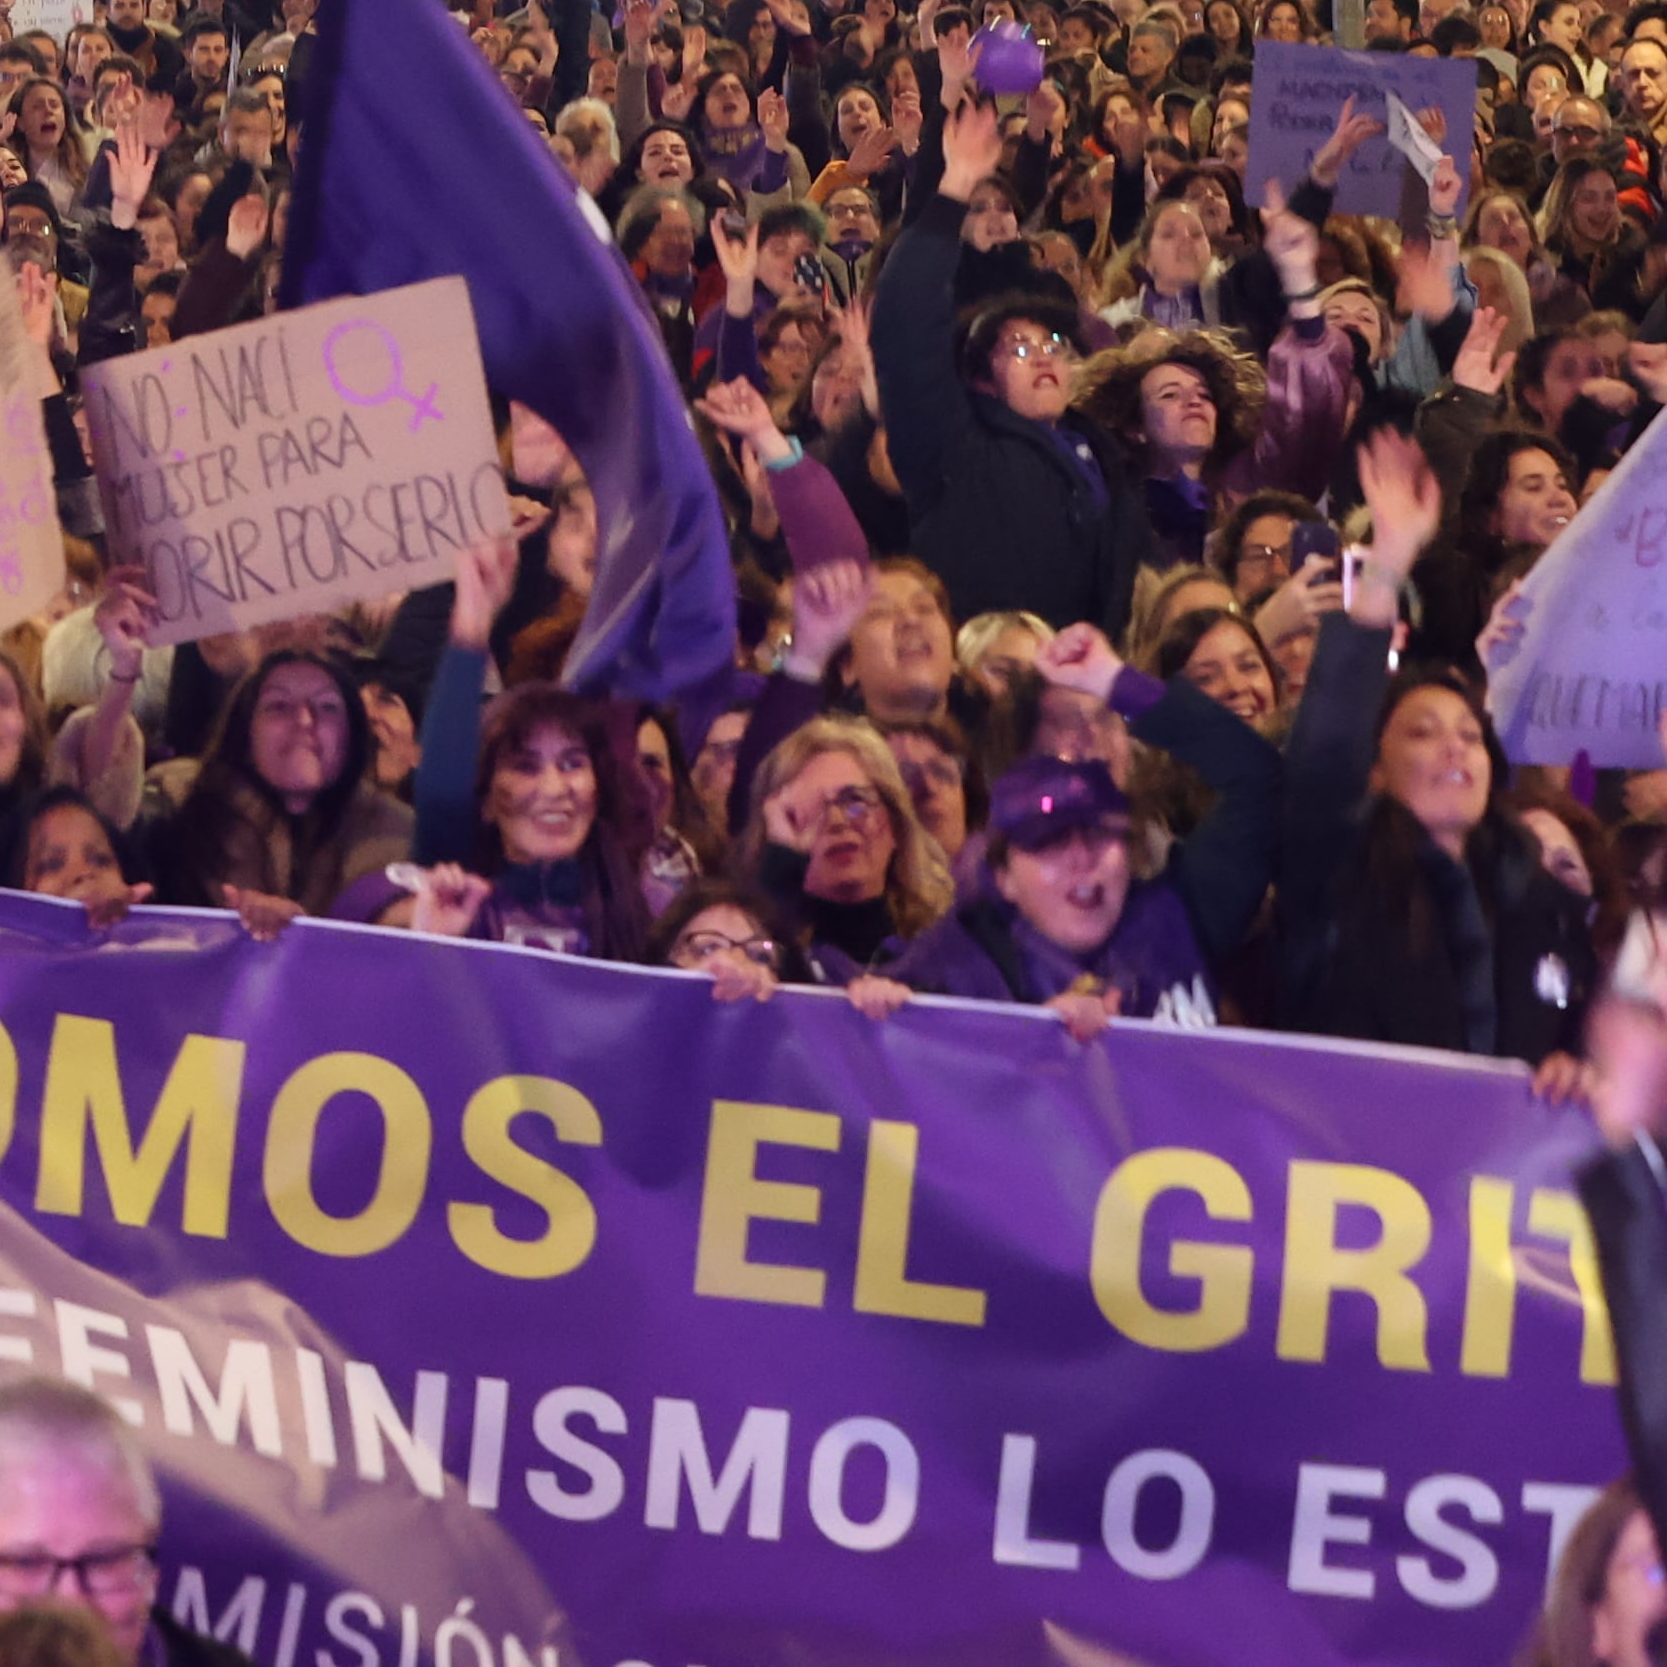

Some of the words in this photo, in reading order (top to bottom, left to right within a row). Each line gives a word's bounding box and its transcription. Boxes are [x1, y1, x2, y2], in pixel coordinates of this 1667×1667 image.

[102, 372, 172, 468] NO
[258, 411, 374, 490] PARA
[276, 491, 378, 591] POR
[694, 1100, 987, 1326] EL
[993, 1431, 1216, 1582] LO
